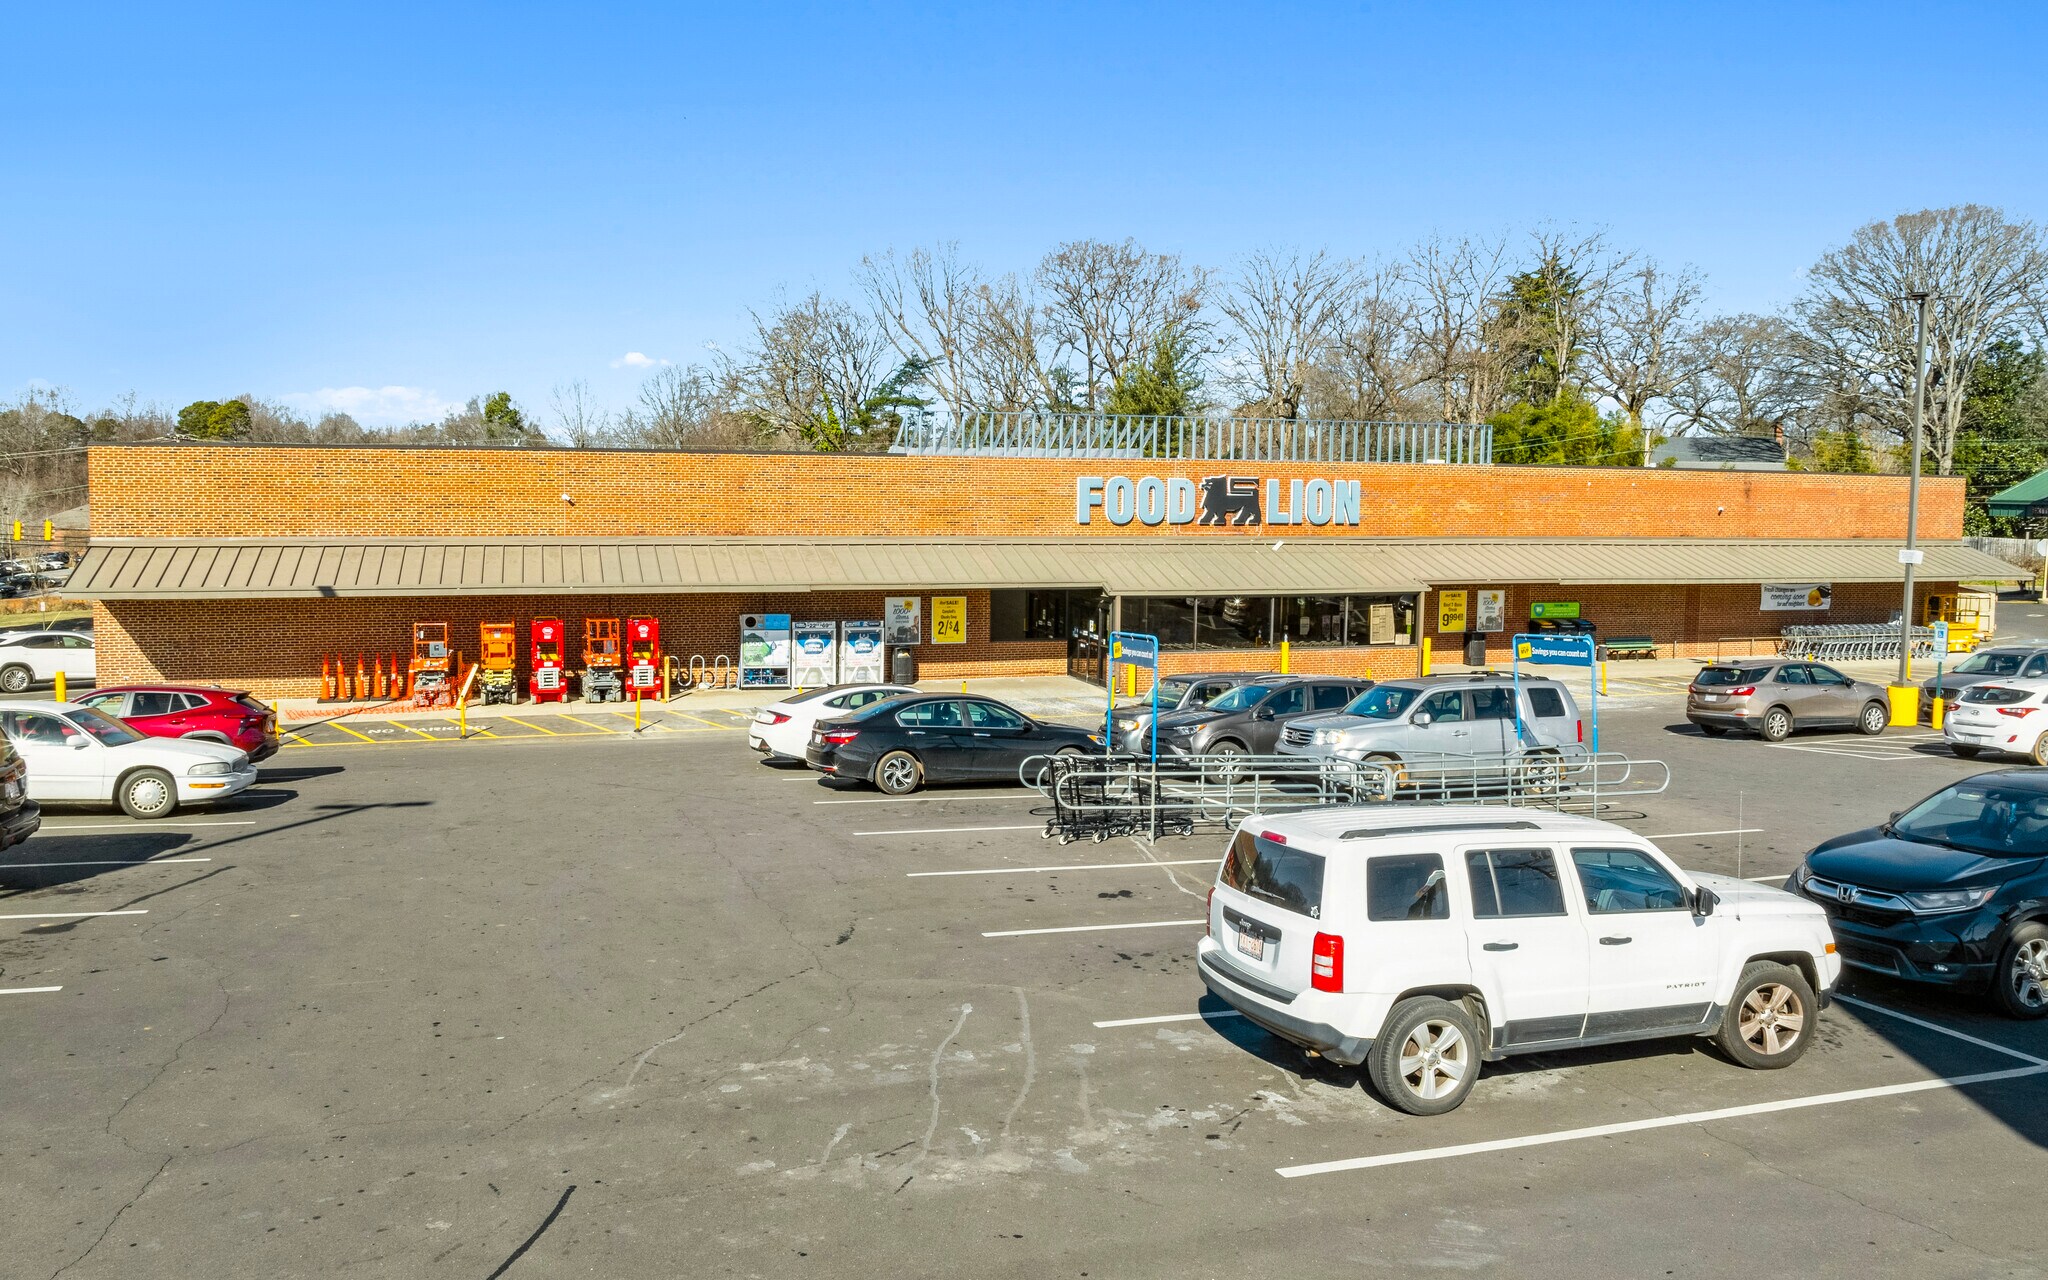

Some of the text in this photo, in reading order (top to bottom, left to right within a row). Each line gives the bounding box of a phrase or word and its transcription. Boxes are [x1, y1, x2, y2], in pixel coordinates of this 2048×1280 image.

[1077, 477, 1361, 526] FOOD LION
[938, 620, 960, 636] 2/$4
[1532, 646, 1548, 657] Savings
[1665, 981, 1707, 990] PATRIOT
